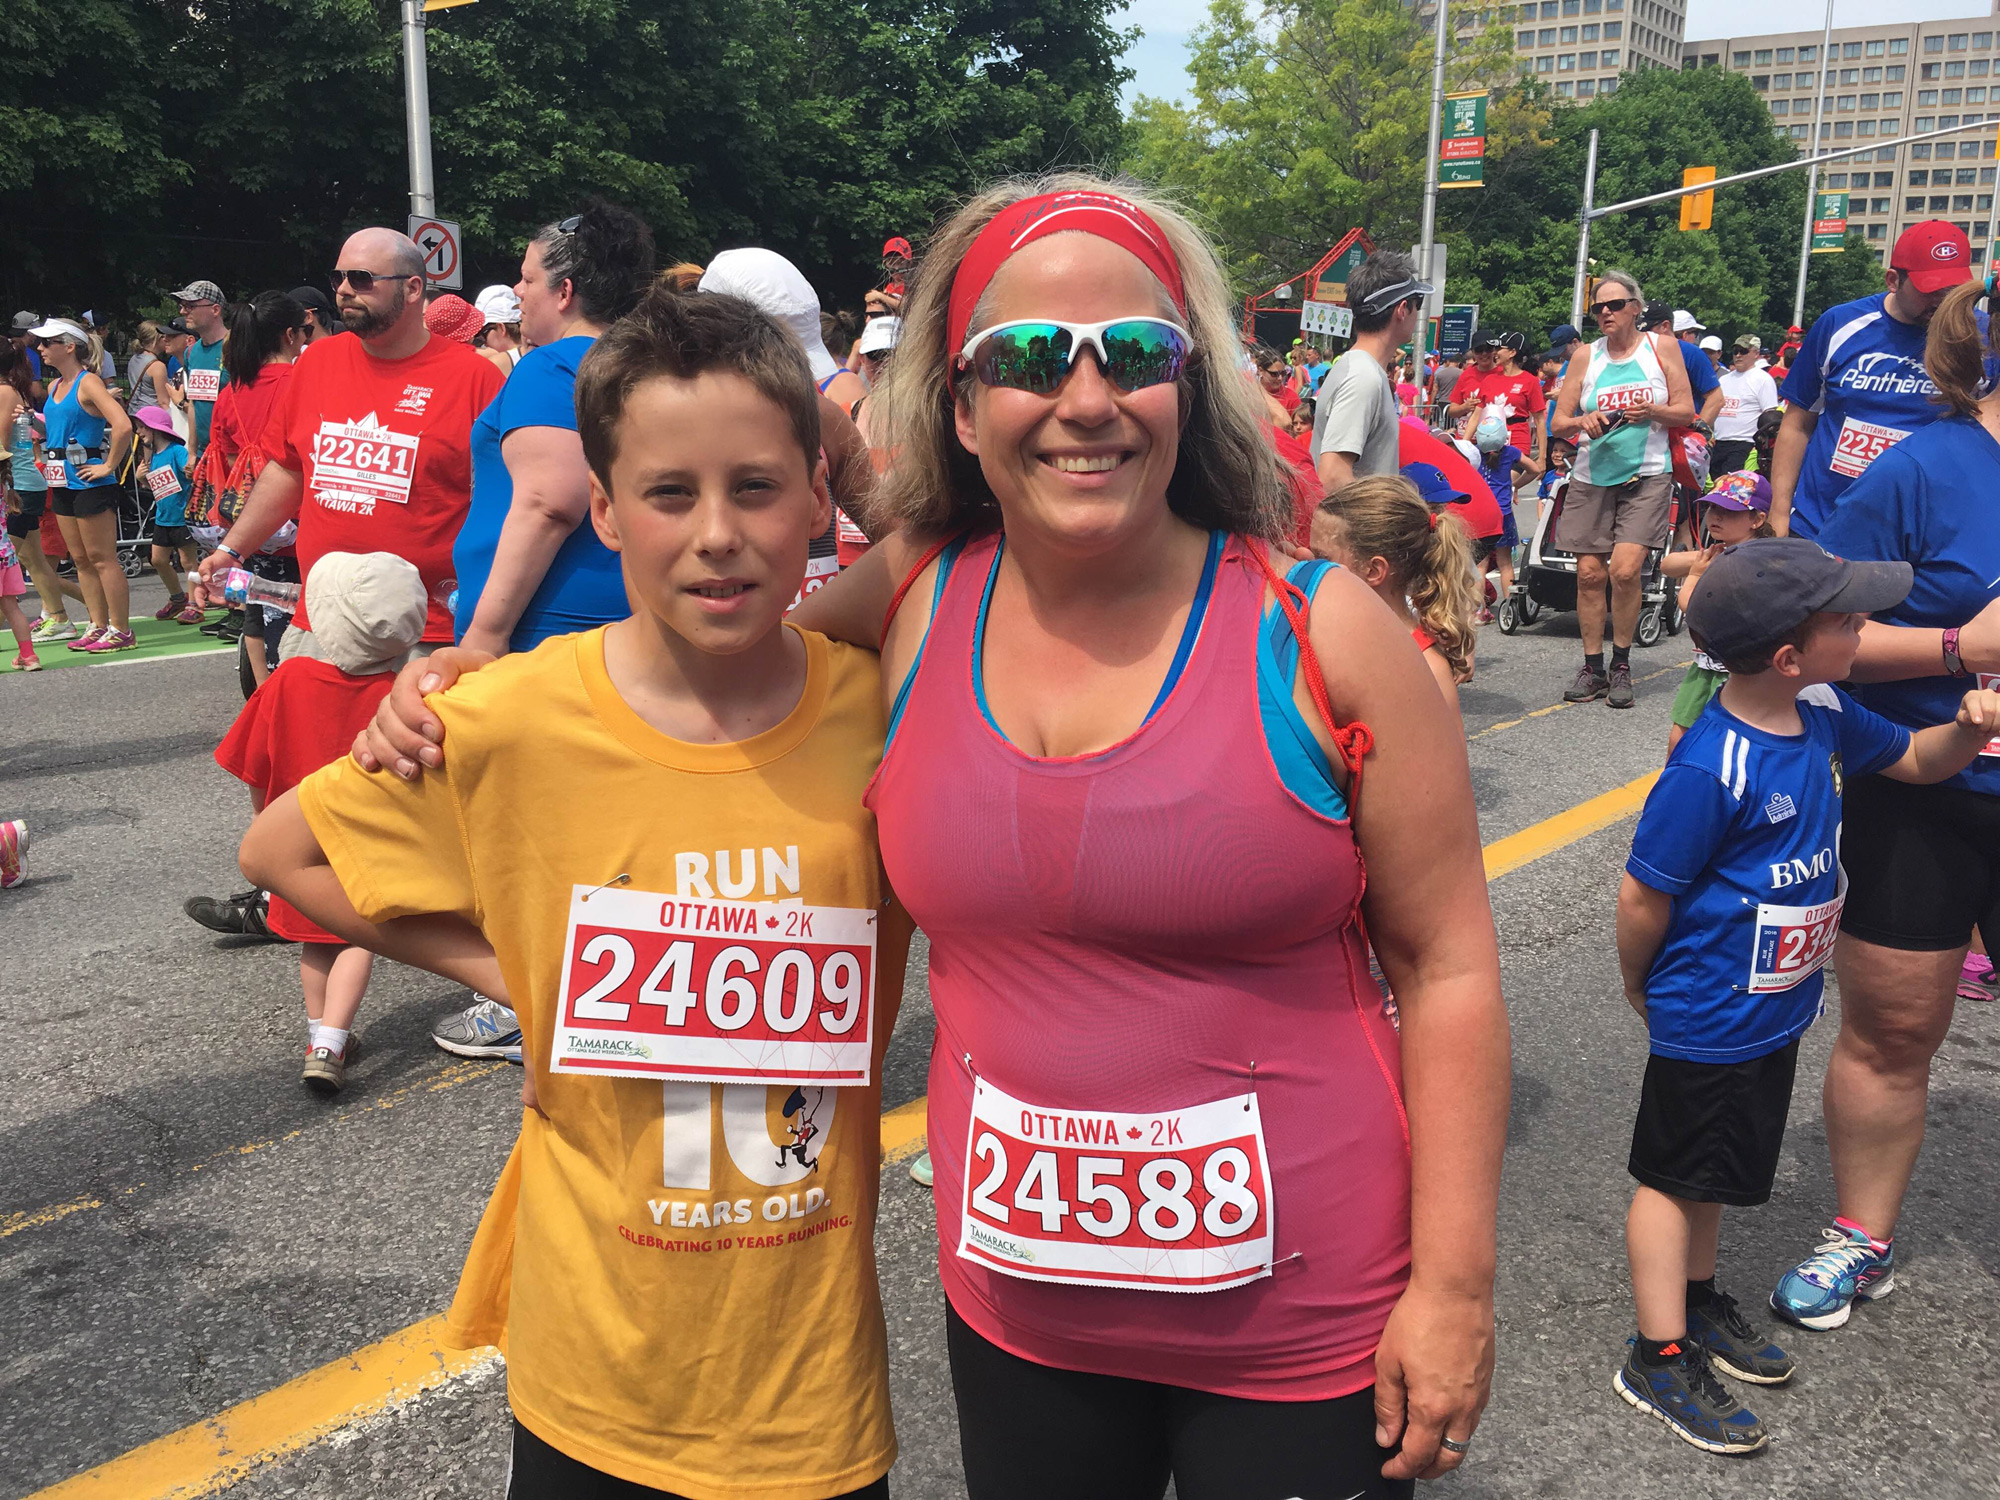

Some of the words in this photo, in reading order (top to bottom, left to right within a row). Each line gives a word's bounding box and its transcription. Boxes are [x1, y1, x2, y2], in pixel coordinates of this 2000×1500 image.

[189, 375, 217, 388] 23532
[1599, 389, 1652, 410] 24460
[344, 427, 374, 440] OTTAWA
[382, 433, 392, 442] 2K
[1861, 424, 1887, 436] OTTAWA
[320, 437, 408, 475] 22641
[357, 471, 377, 480] GILLES
[358, 503, 376, 516] 2K
[809, 562, 821, 575] 2K
[675, 845, 800, 899] RUN
[1769, 848, 1833, 889] BMO
[660, 901, 758, 935] OTTAWA
[785, 911, 814, 938] 2K
[573, 933, 863, 1035] 24609
[568, 1035, 634, 1051] TAMARACK
[1020, 1110, 1120, 1146] OTTAWA
[1150, 1117, 1184, 1147] 2K
[971, 1131, 1260, 1242] 24588
[647, 1199, 753, 1229] YEARS
[762, 1187, 832, 1223] OLD.
[618, 1224, 713, 1253] CELEBRATING
[716, 1238, 733, 1250] 10
[736, 1233, 784, 1249] YEARS
[787, 1214, 853, 1244] RUNNING.
[970, 1223, 1017, 1253] TAMARACK
